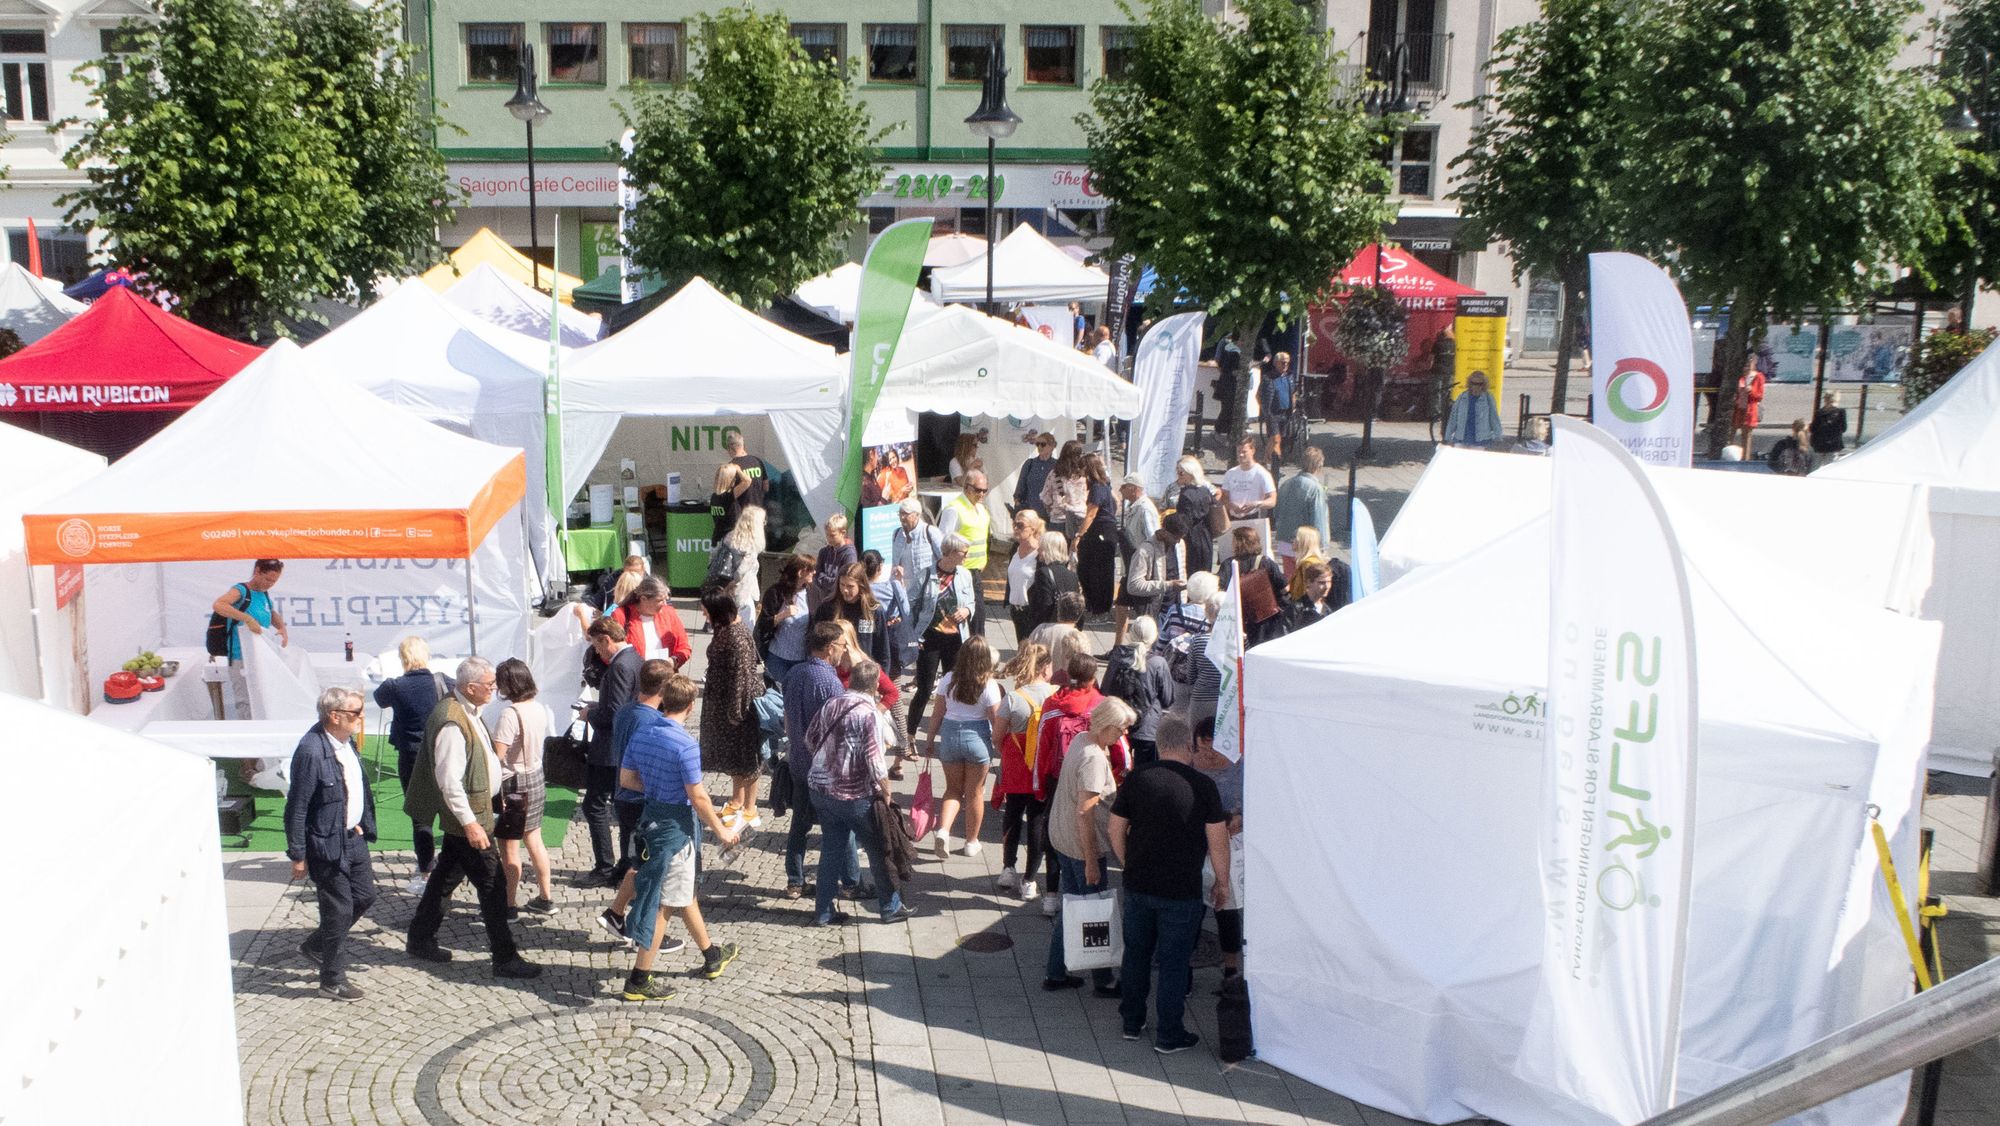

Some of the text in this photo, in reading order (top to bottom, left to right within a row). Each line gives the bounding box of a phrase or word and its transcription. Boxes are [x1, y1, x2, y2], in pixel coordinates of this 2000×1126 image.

[460, 176, 618, 196] Saigon Cafe Cecilie
[1052, 170, 1080, 186] The
[20, 385, 170, 407] TEAM RUBICON
[671, 425, 741, 451] NITO
[210, 529, 237, 539] 02409
[676, 539, 712, 553] NITO
